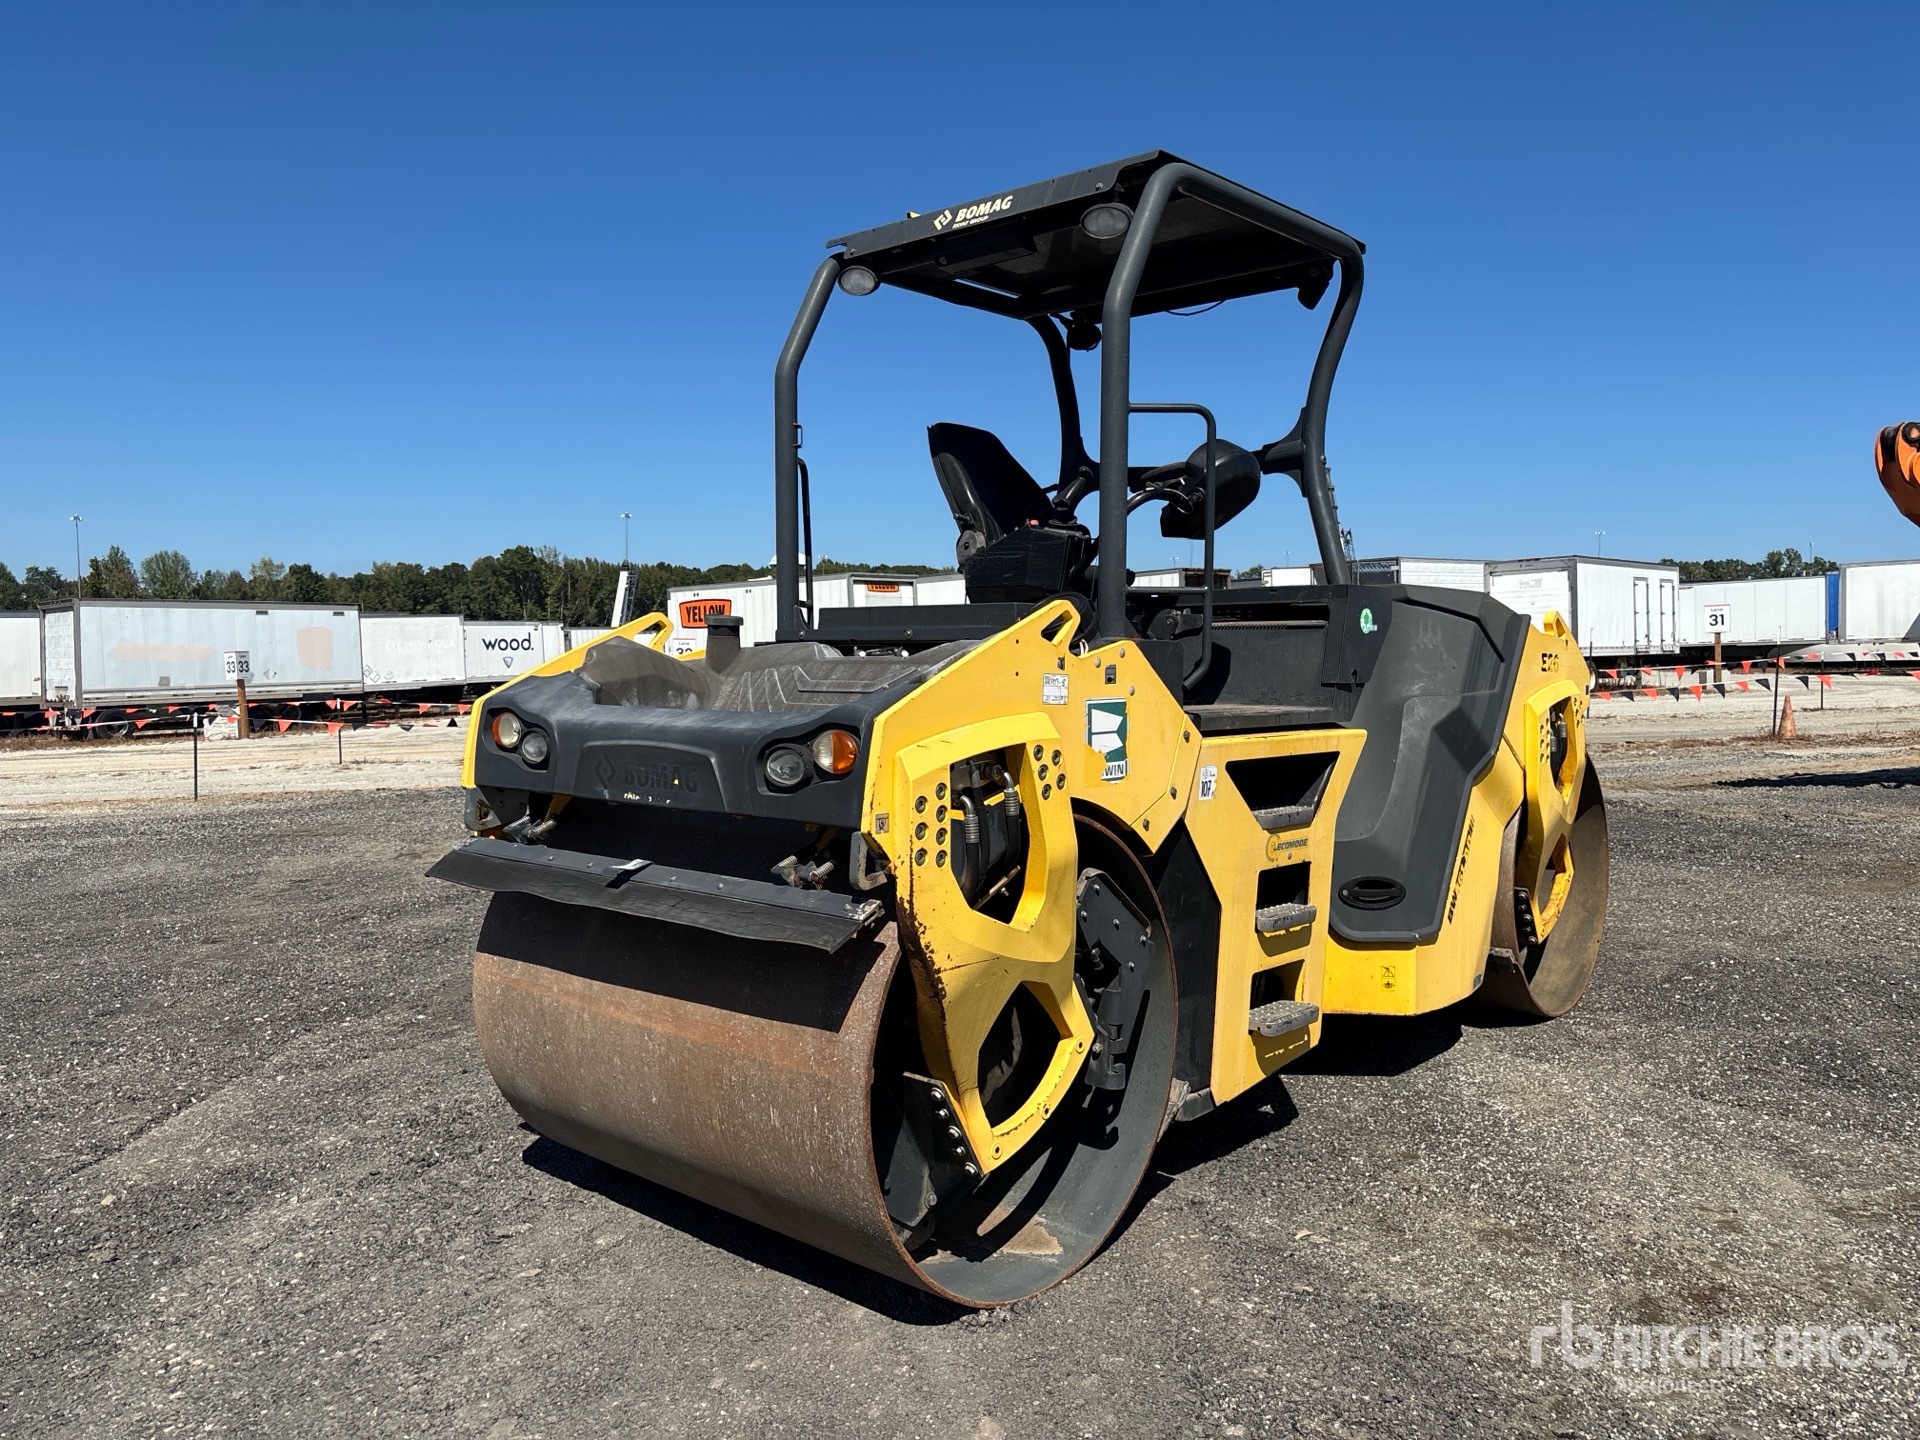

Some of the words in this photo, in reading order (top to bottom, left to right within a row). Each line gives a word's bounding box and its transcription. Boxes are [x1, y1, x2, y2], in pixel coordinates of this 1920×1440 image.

[954, 195, 1014, 223] BOMAG
[685, 604, 726, 623] YELLOW
[1709, 613, 1725, 626] 31
[482, 632, 535, 651] wood.
[226, 661, 236, 674] 33
[238, 660, 250, 673] 33
[623, 761, 699, 794] BOMAG
[1102, 763, 1125, 777] WIN
[1201, 780, 1212, 797] 107
[1276, 838, 1309, 852] ECOMODE
